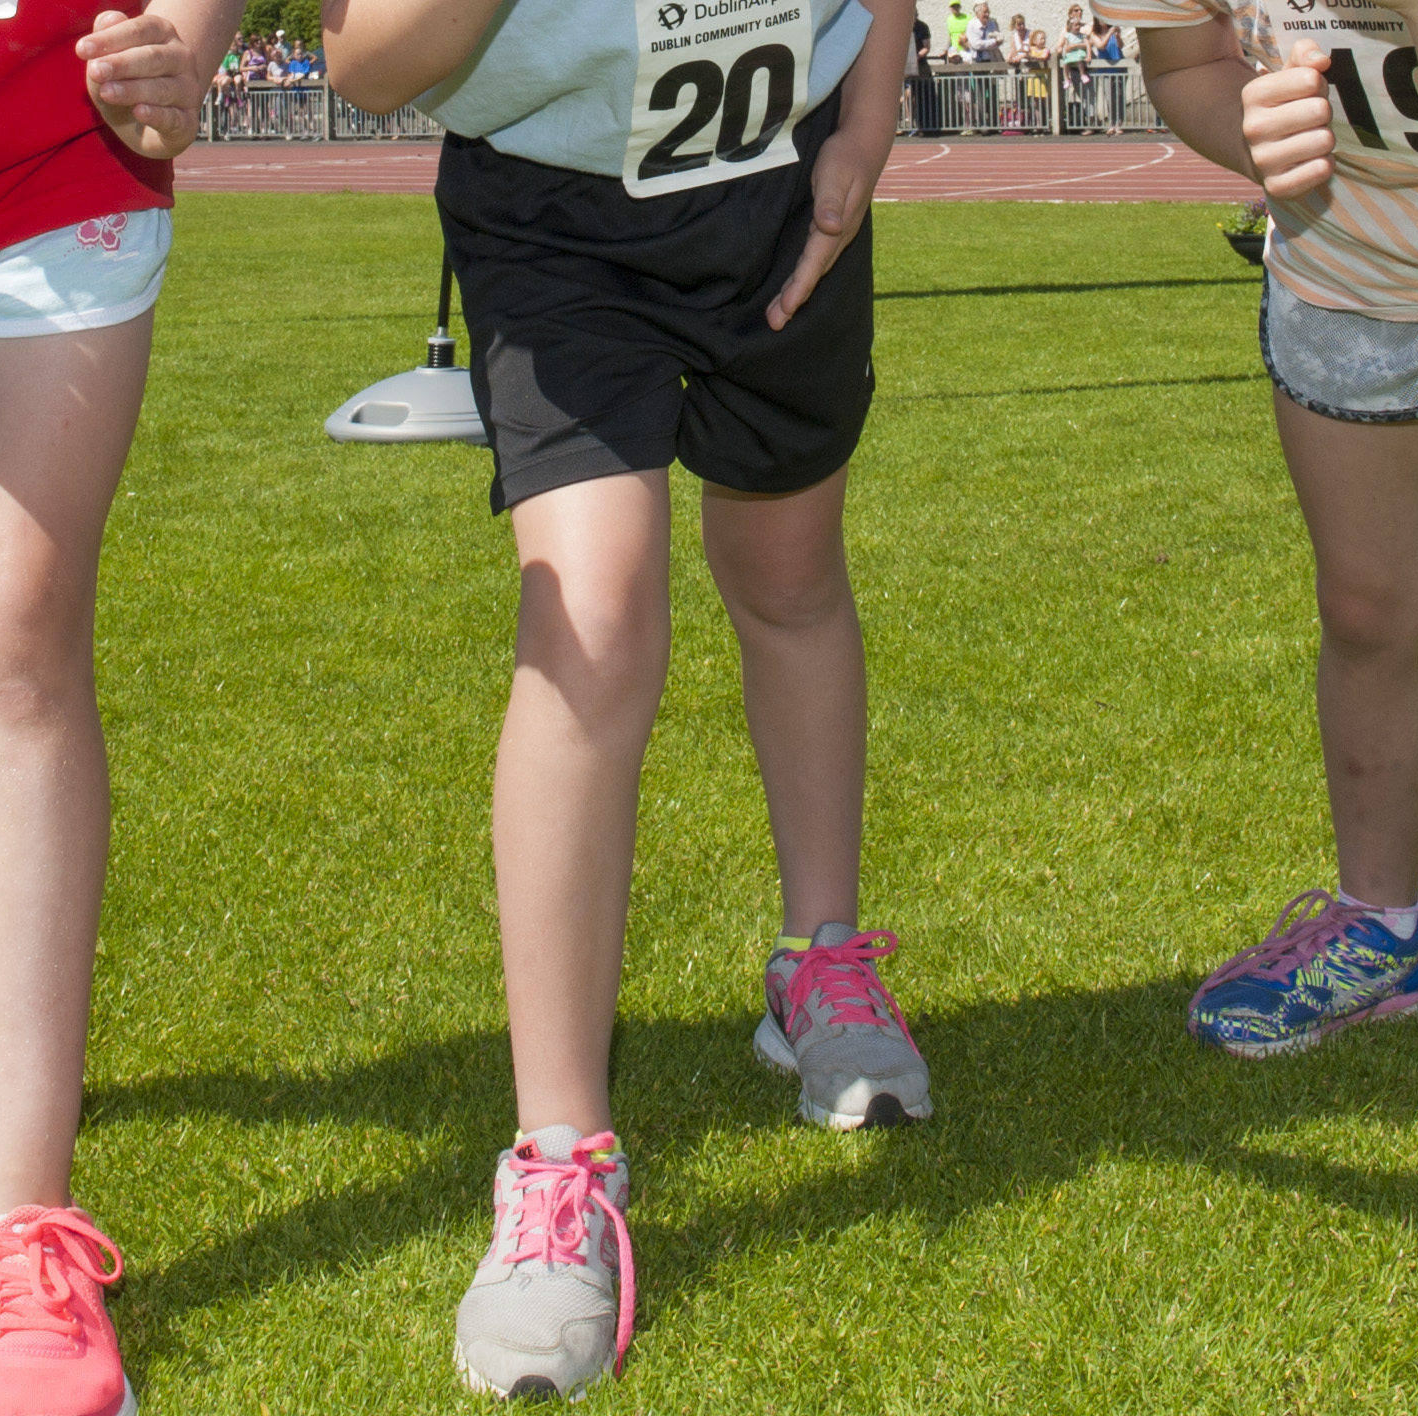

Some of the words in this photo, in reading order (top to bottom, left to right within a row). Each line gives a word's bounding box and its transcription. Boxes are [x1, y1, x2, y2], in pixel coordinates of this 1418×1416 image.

[651, 35, 691, 53] DUBLIN
[695, 19, 761, 44] COMMUNITY
[765, 8, 800, 28] GAMES
[1283, 20, 1327, 31] DUBLIN
[1330, 19, 1404, 32] COMMUNITY
[637, 43, 795, 181] 20
